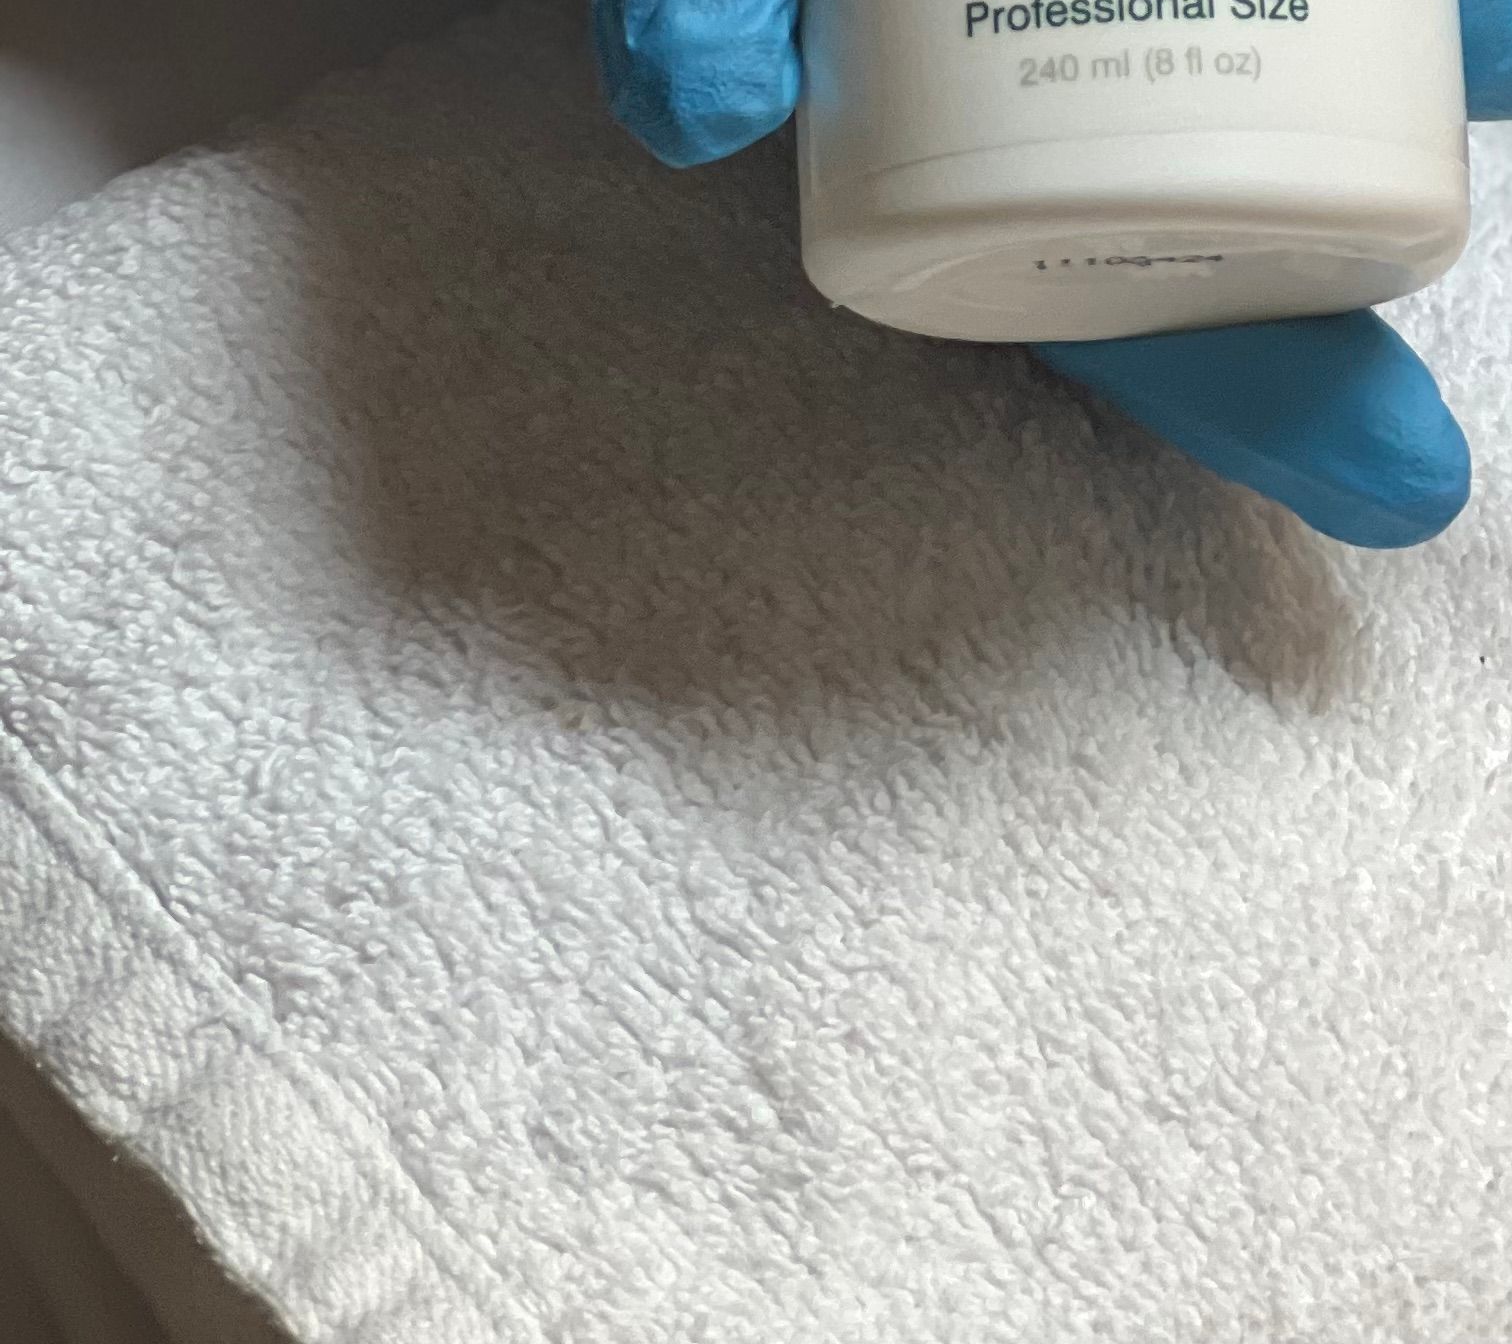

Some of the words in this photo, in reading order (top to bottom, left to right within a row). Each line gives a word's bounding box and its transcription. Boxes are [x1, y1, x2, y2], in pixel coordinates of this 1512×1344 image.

[1017, 52, 1081, 89] 240
[1090, 48, 1131, 81] ml
[1143, 46, 1176, 85] (8
[1184, 45, 1204, 77] fl
[1213, 45, 1263, 83] oz)
